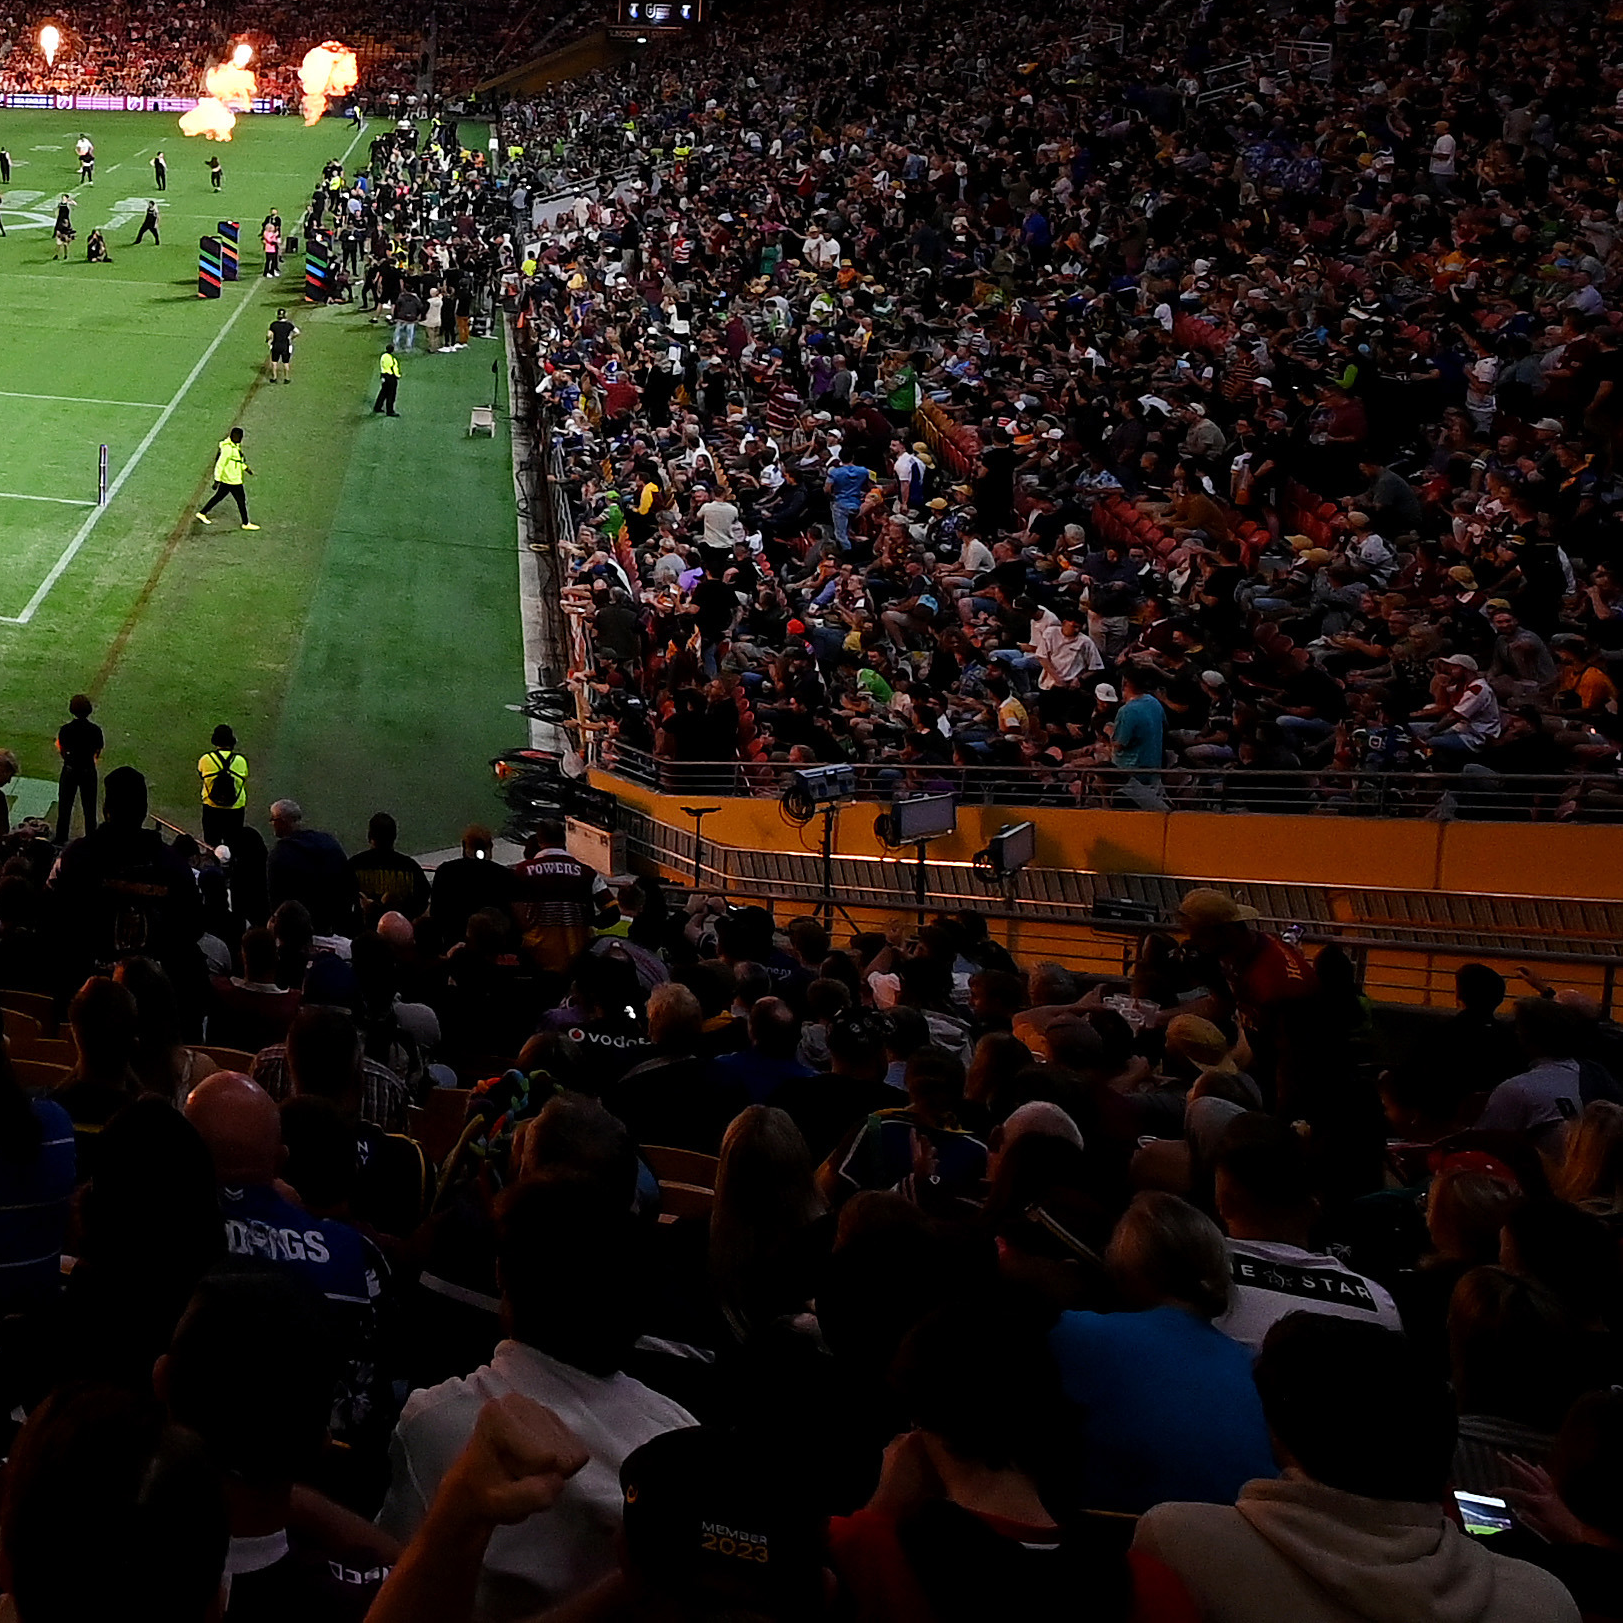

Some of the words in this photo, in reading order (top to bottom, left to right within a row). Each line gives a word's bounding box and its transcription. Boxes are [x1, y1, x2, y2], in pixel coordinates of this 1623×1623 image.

[526, 861, 582, 877] POWERS
[1301, 1275, 1374, 1302] STAR
[700, 1521, 768, 1546] MEMBER
[700, 1532, 769, 1565] 2023
